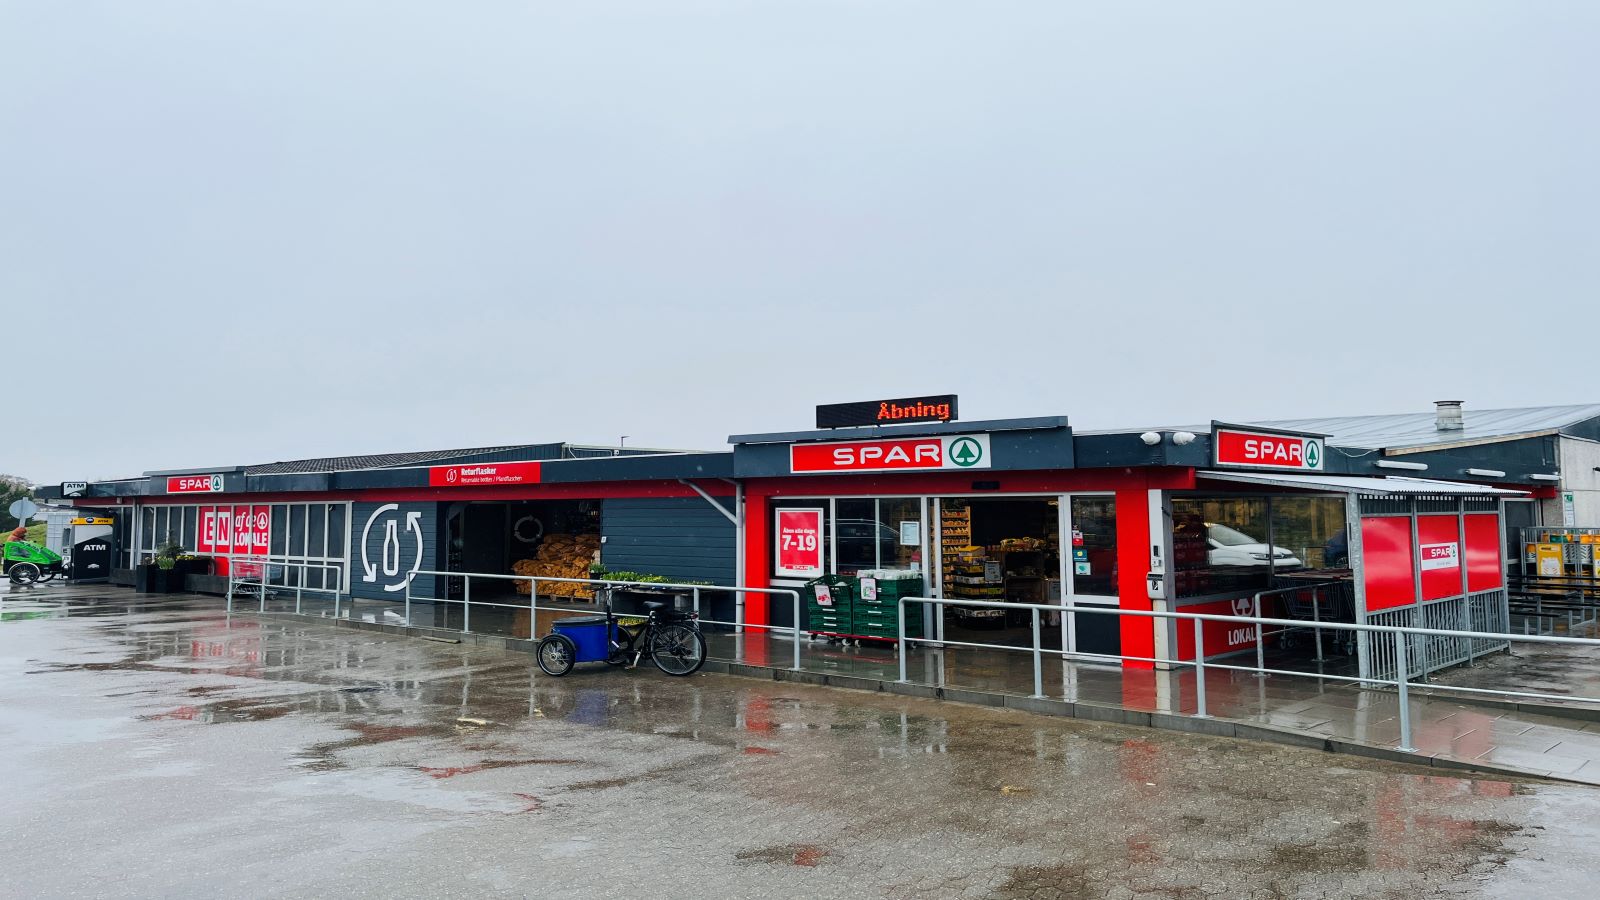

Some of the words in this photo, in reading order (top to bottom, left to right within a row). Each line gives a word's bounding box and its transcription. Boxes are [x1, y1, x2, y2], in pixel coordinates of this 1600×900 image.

[877, 401, 950, 420] Åbning
[833, 444, 940, 466] SPAR
[1244, 439, 1302, 462] SPAR
[179, 479, 212, 490] SPAR
[205, 514, 231, 543] EN
[782, 534, 817, 552] 7-19
[1431, 547, 1451, 558] SPAR
